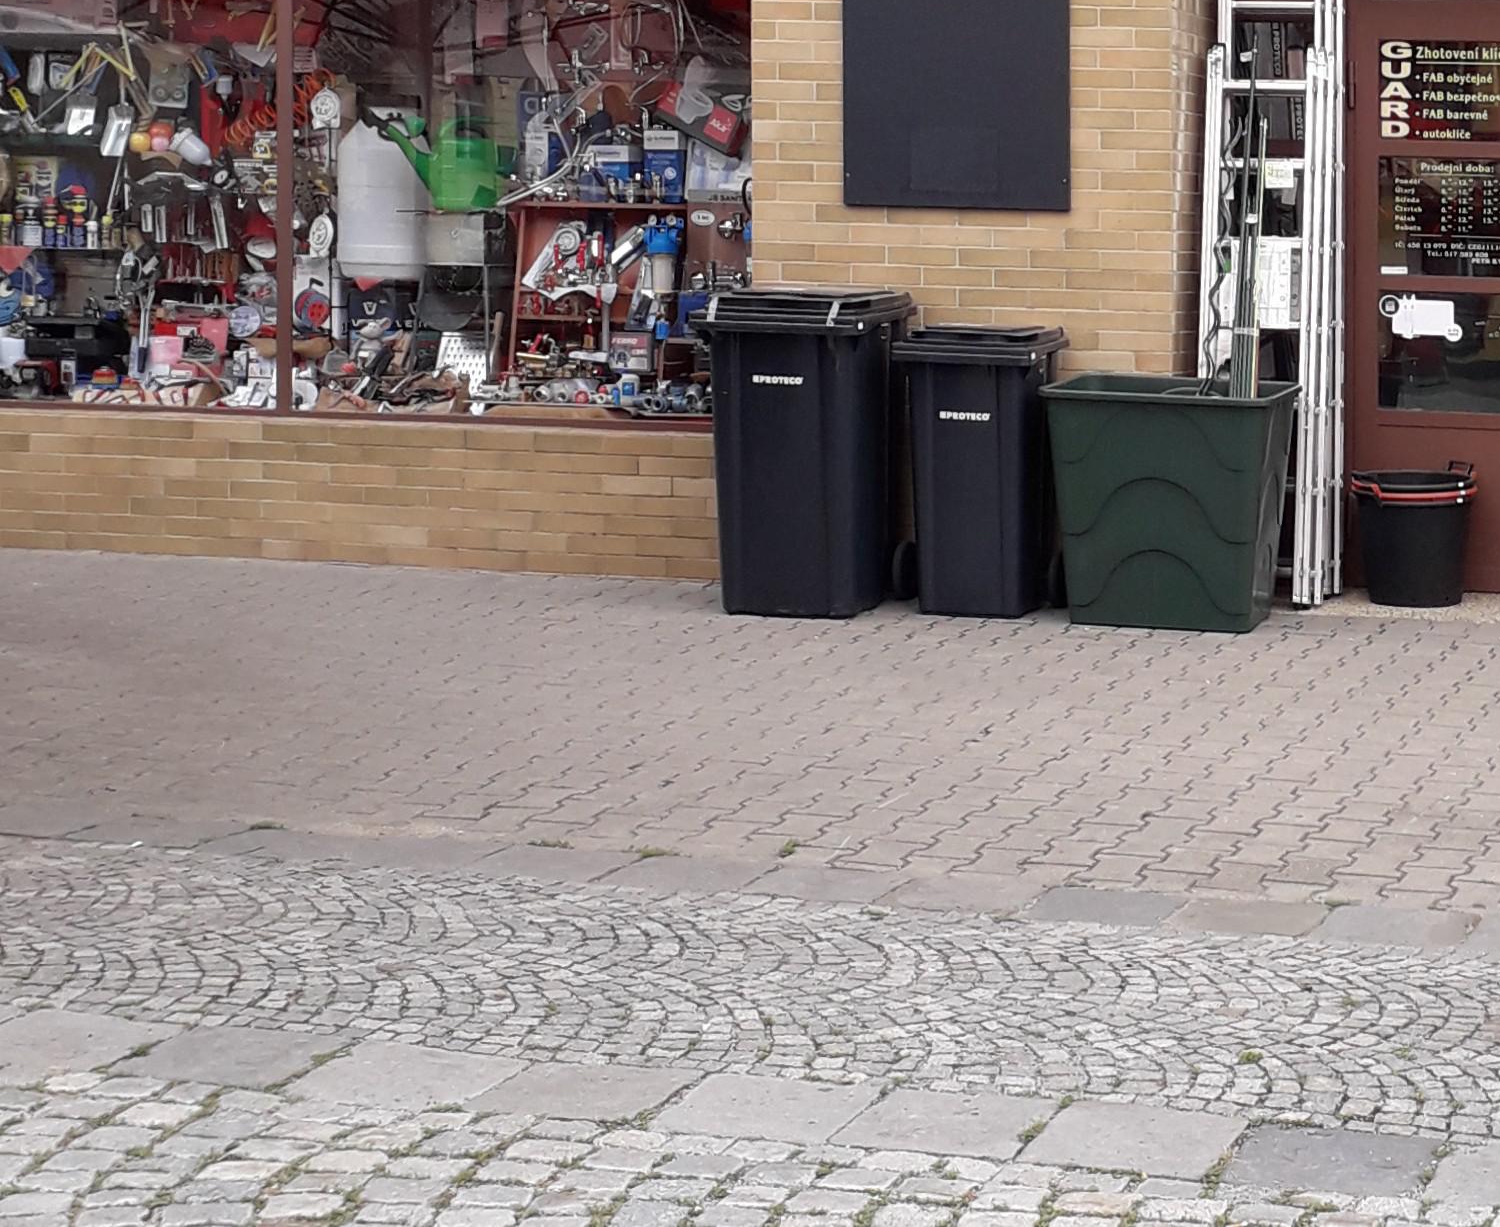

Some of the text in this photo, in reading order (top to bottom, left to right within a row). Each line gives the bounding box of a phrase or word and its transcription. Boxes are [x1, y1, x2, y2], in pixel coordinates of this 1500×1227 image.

[1415, 46, 1479, 60] Zhotovení
[1422, 73, 1493, 86] FAB obyčejné
[1422, 91, 1444, 101] FAB
[1422, 109, 1488, 120] FAB barevné
[1422, 129, 1471, 139] autoklíče
